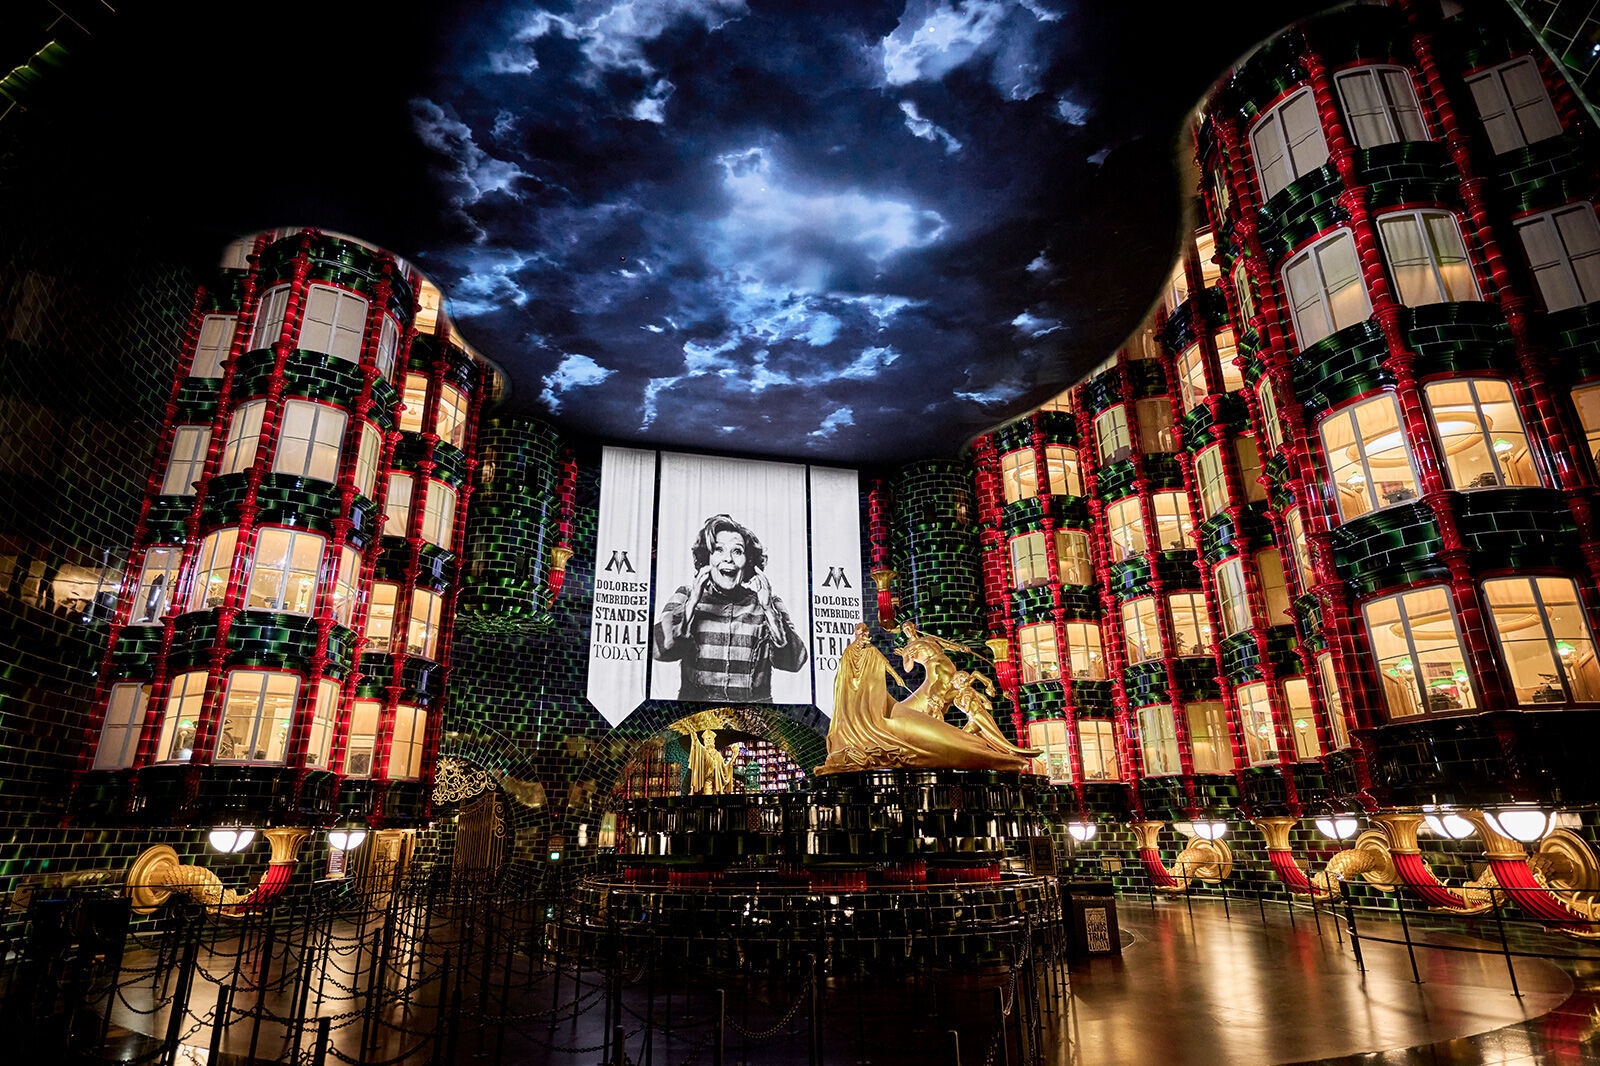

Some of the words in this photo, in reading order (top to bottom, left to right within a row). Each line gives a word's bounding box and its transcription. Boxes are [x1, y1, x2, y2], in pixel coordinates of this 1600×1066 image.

[596, 579, 648, 592] DOLORES
[595, 593, 647, 606] UMBRIDGE
[814, 594, 860, 607] DOLORES
[595, 606, 647, 622] STANDS
[814, 607, 860, 620] UMBRIDGE
[595, 622, 646, 645] TRIAL
[593, 644, 646, 661] TODAY
[816, 636, 851, 656] TRI
[1088, 932, 1108, 941] TRIAL
